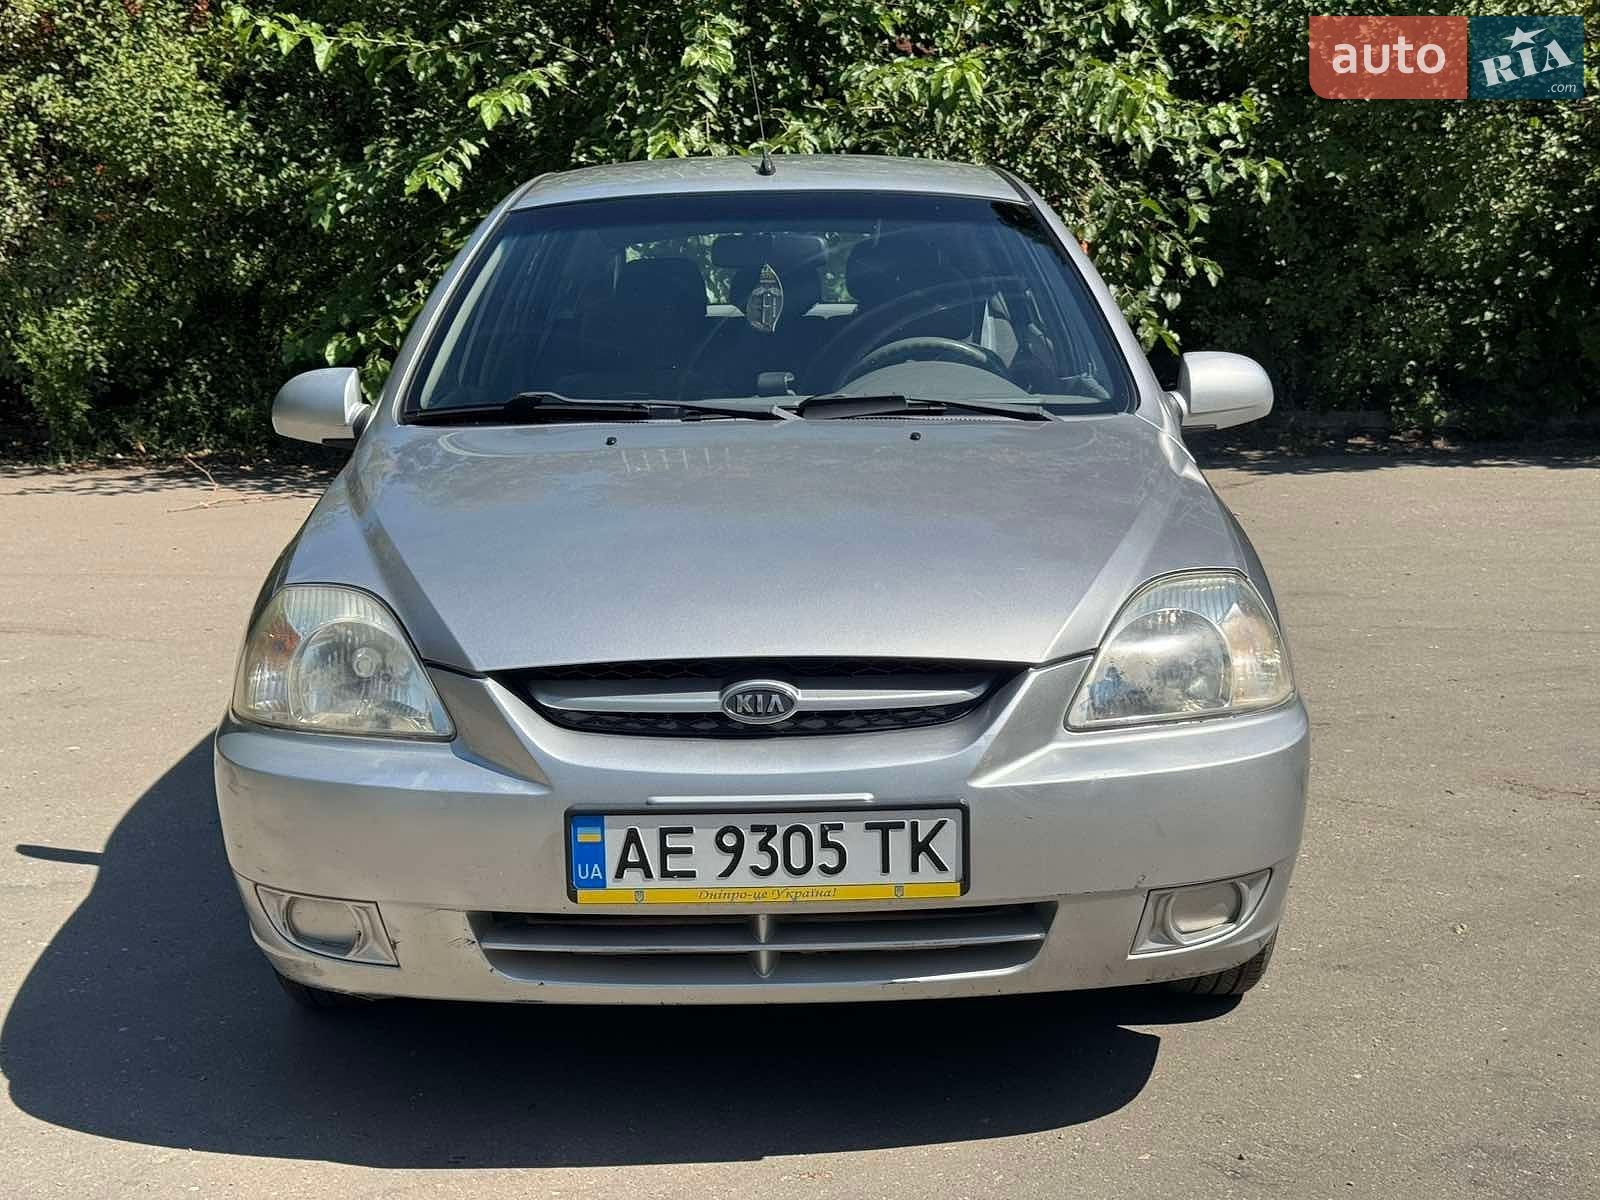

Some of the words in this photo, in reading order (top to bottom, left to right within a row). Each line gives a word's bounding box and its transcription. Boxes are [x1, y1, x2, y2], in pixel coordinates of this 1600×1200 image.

[736, 694, 785, 713] KIA
[613, 826, 697, 879] AE
[714, 821, 847, 878] 9305
[865, 819, 950, 875] TK
[577, 864, 602, 879] UA
